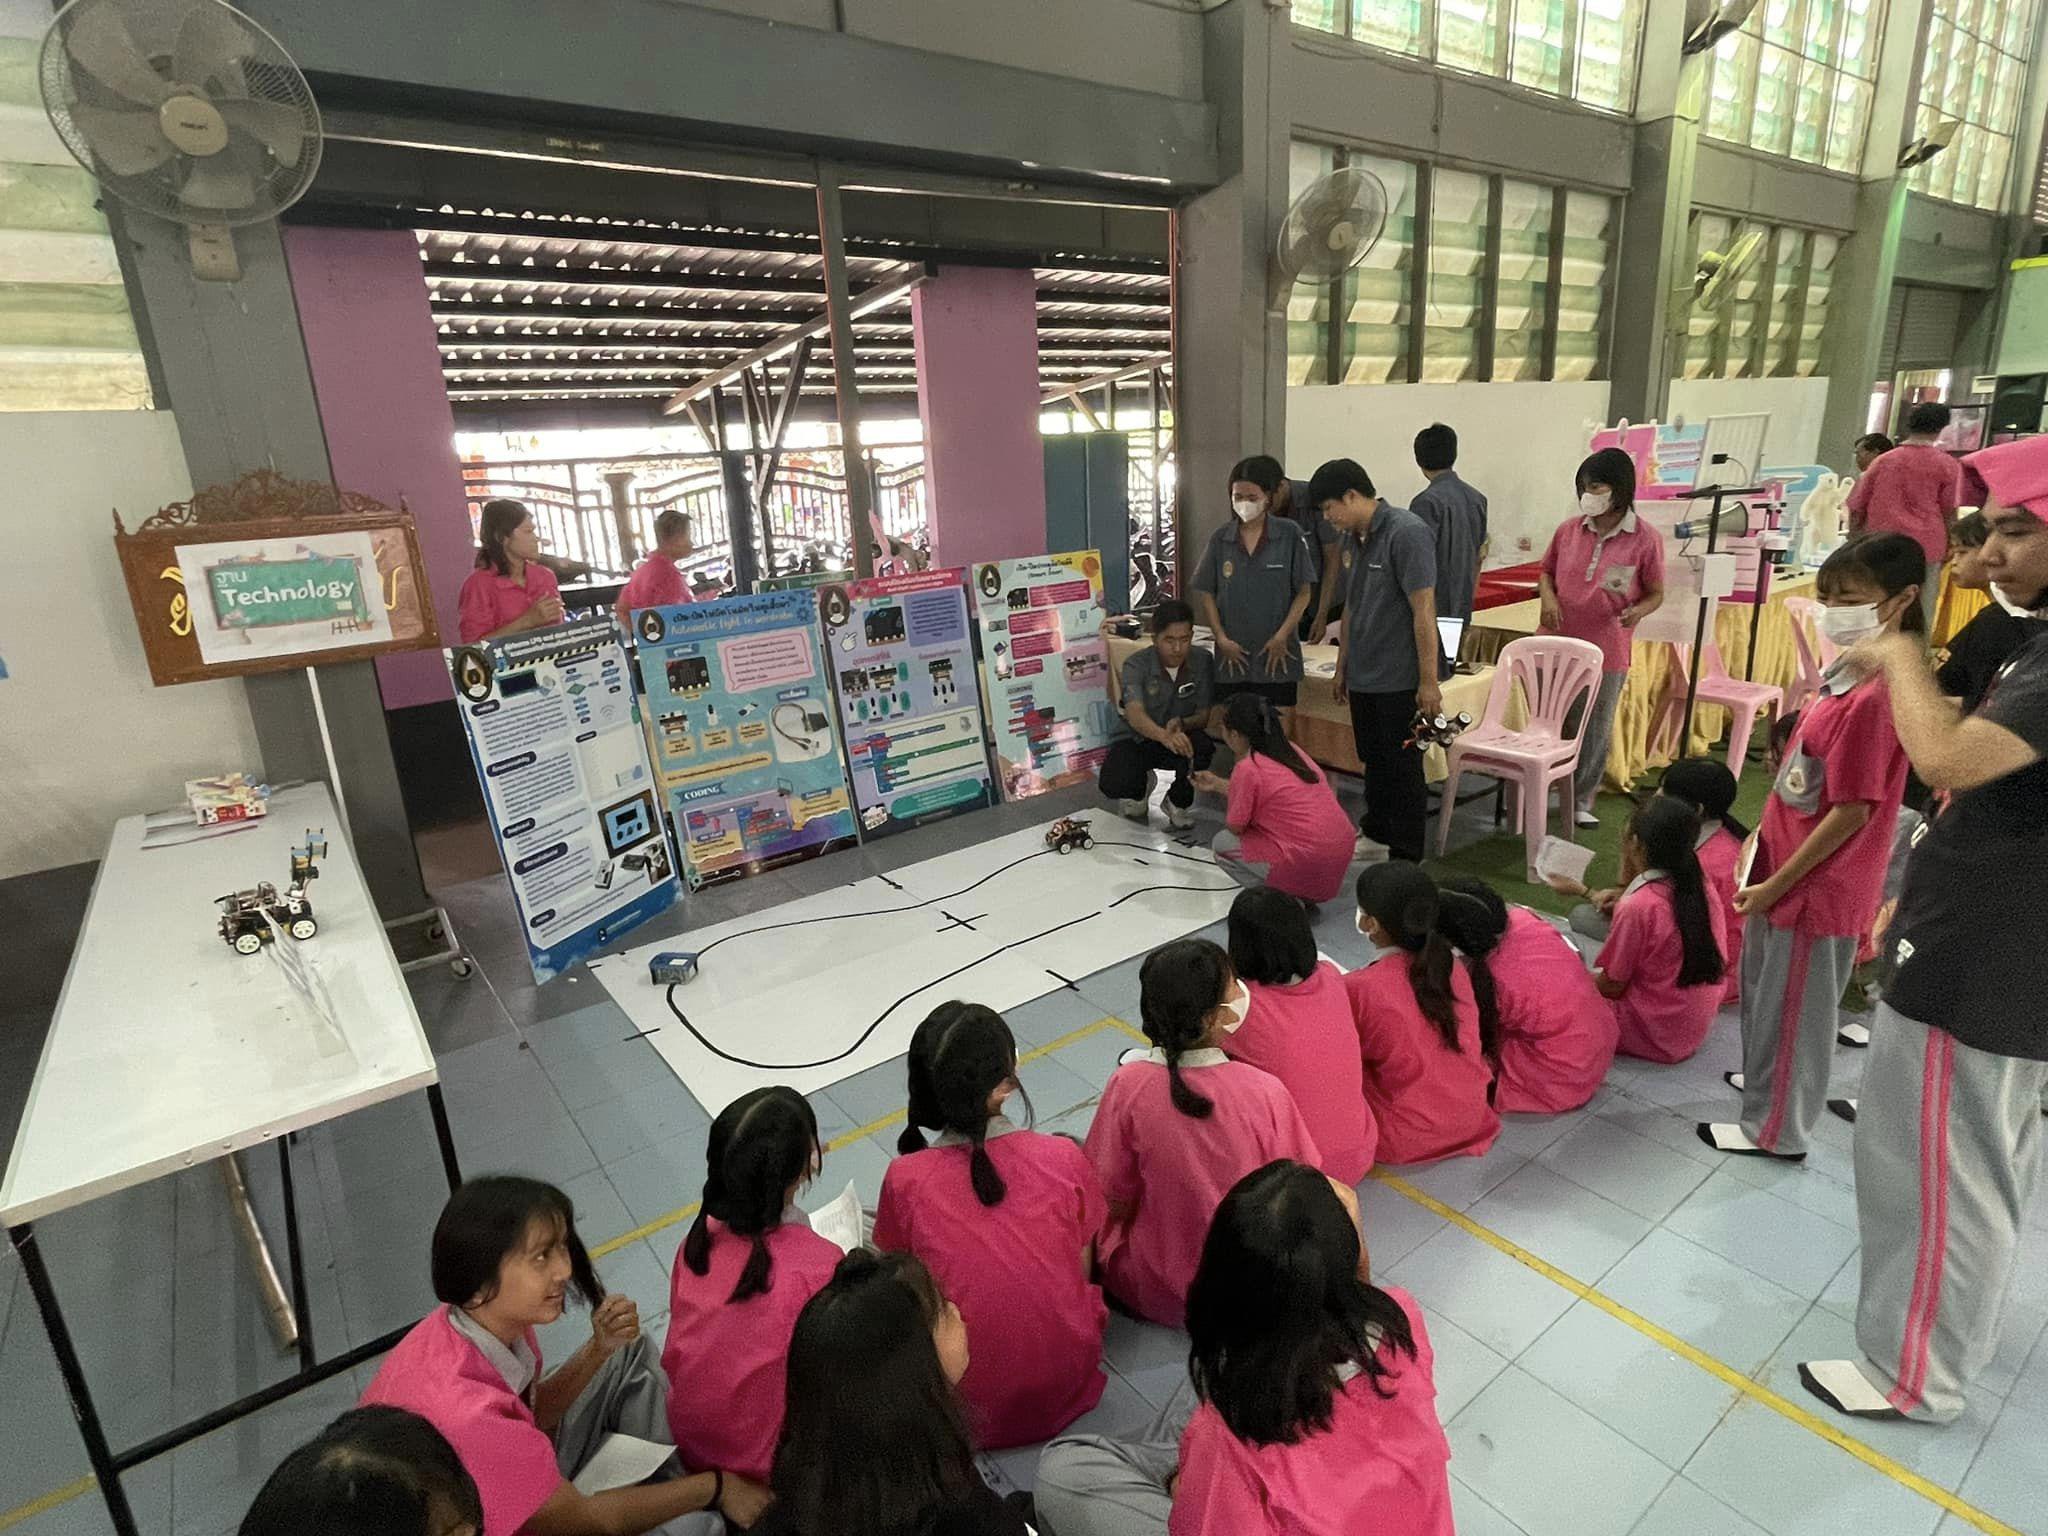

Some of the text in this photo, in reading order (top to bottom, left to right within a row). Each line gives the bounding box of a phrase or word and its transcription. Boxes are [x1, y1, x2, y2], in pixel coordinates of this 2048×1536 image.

[214, 571, 248, 588] ฐาน
[221, 579, 355, 607] Technology
[684, 784, 721, 801] CODING
